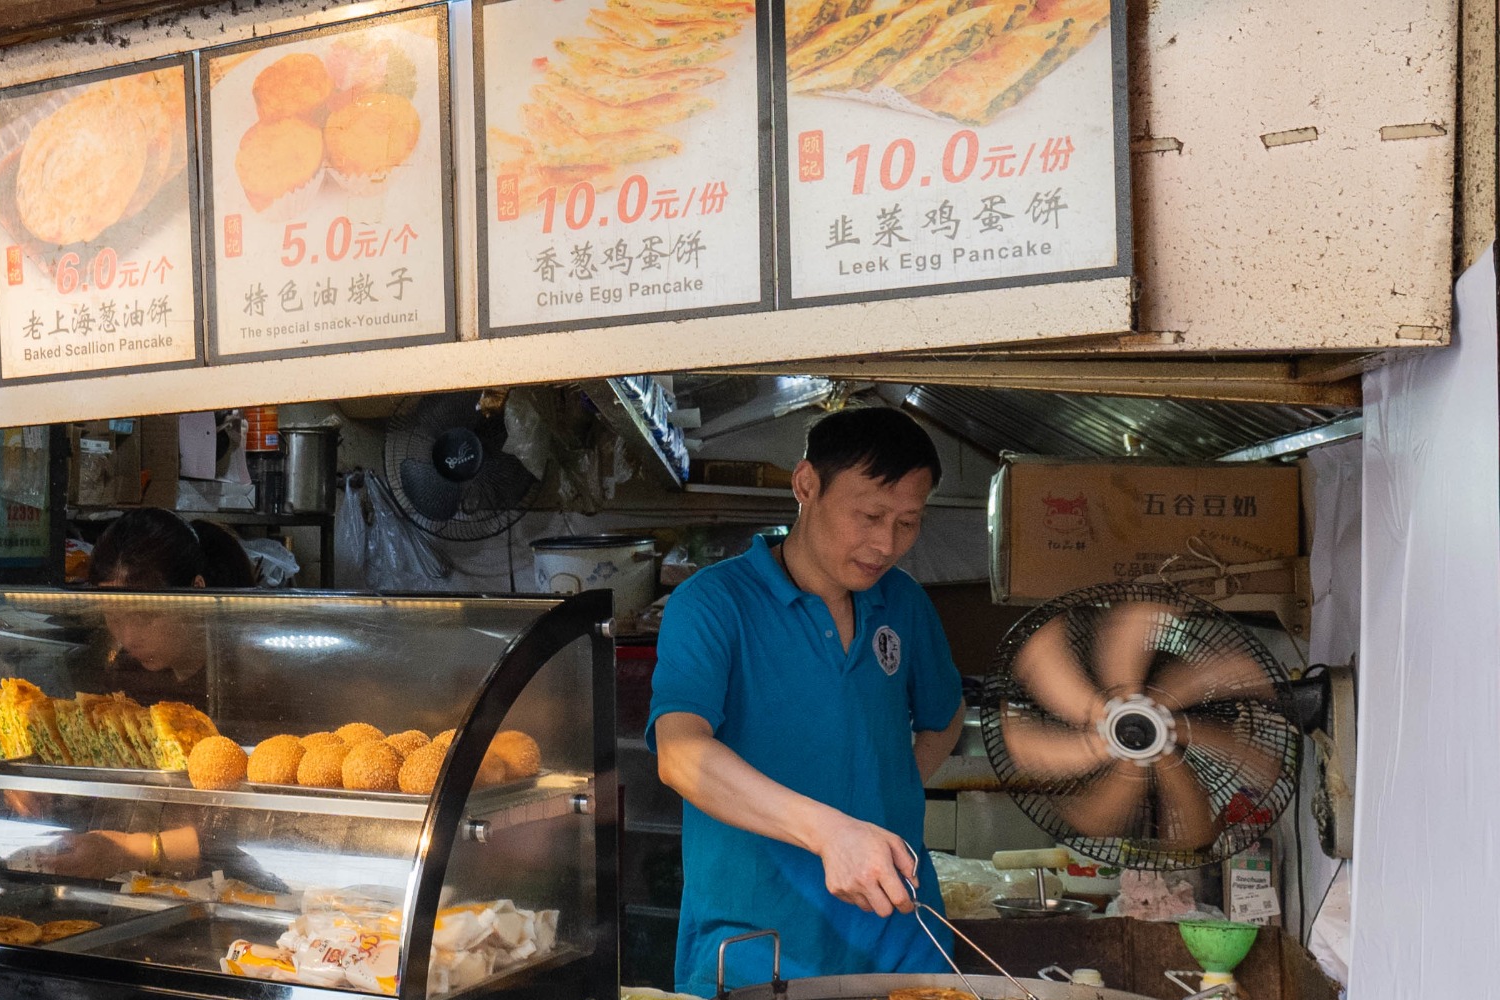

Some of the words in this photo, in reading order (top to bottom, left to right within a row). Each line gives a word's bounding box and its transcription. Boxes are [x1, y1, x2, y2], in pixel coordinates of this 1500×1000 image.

[844, 130, 1076, 195] 10.0元/份
[536, 174, 729, 234] 10.0元/份
[825, 187, 1069, 249] 韭菜鸡蛋饼
[281, 217, 419, 268] 5.0元/个
[533, 230, 708, 284] 香葱鸡蛋饼
[839, 256, 889, 276] Leek
[900, 252, 942, 272] Egg
[953, 241, 1052, 264] Pancake
[56, 247, 174, 295] 6.0元/个
[243, 267, 414, 317] 特色油墩子
[537, 289, 584, 307] Chive
[590, 286, 623, 304] Egg
[629, 277, 703, 298] Pancake
[22, 294, 173, 341] 老上海葱油饼
[240, 326, 263, 340] The
[266, 320, 310, 338] special
[314, 309, 419, 331] snack-Youdunzi
[24, 347, 61, 361] Baked
[65, 342, 115, 357] Scallion
[119, 335, 173, 350] Pancake
[1143, 493, 1259, 519] 五谷豆奶
